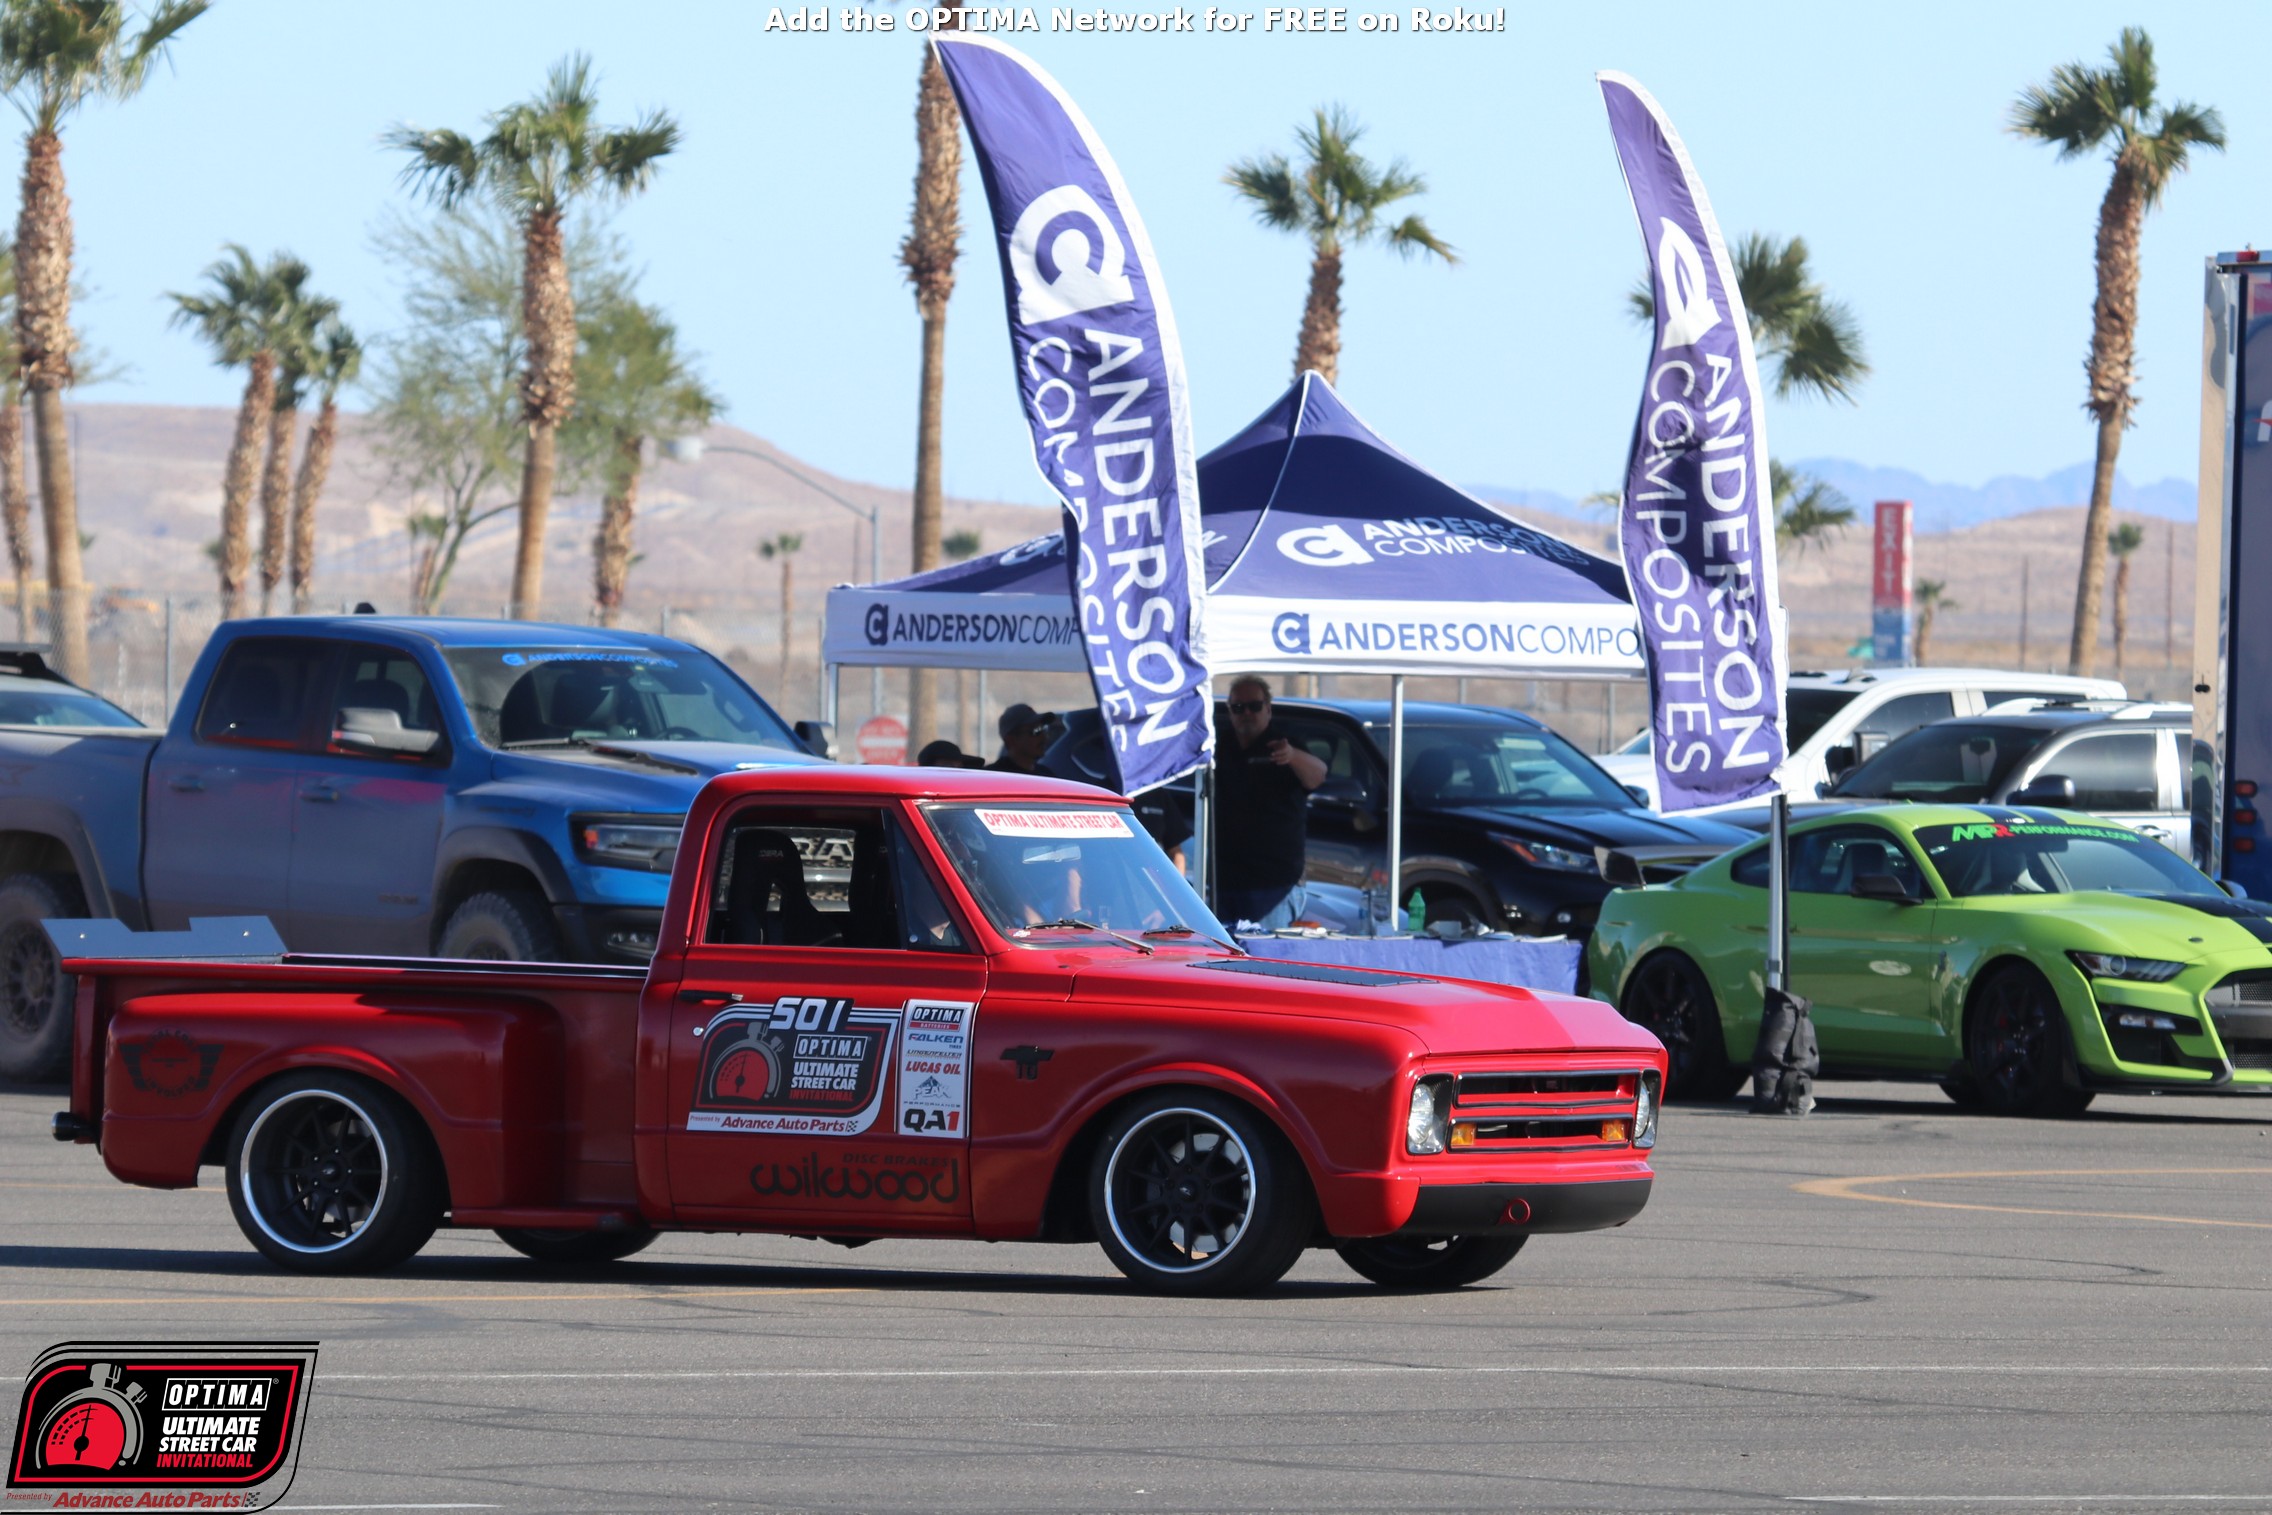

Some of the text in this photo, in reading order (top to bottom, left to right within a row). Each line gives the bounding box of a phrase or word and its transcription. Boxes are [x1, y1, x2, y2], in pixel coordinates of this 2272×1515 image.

[1085, 329, 1187, 746] ANDERSON
[1363, 517, 1570, 548] ANDERSON
[1374, 535, 1590, 566] COMPOSITES
[1635, 360, 1712, 774] COMPOSITES
[1701, 353, 1769, 769] ANDERSON
[983, 812, 1124, 829] OPTIMA ULTIMATE STREET CAR
[769, 997, 845, 1032] 501
[914, 1008, 961, 1022] OPTIMA
[908, 1033, 964, 1043] FALKEN
[798, 1038, 862, 1057] OPTIMA
[793, 1062, 859, 1077] ULTIMATE
[905, 1061, 960, 1075] LUCAS OIL
[791, 1076, 857, 1091] STREET CAR
[790, 1089, 854, 1102] INVITATIONAL
[721, 1116, 774, 1130] Advance
[775, 1118, 808, 1131] Auto
[809, 1119, 845, 1133] Parts
[903, 1108, 960, 1133] QA1
[842, 1153, 949, 1168] DISC BRAKES
[750, 1151, 960, 1204] wilwood
